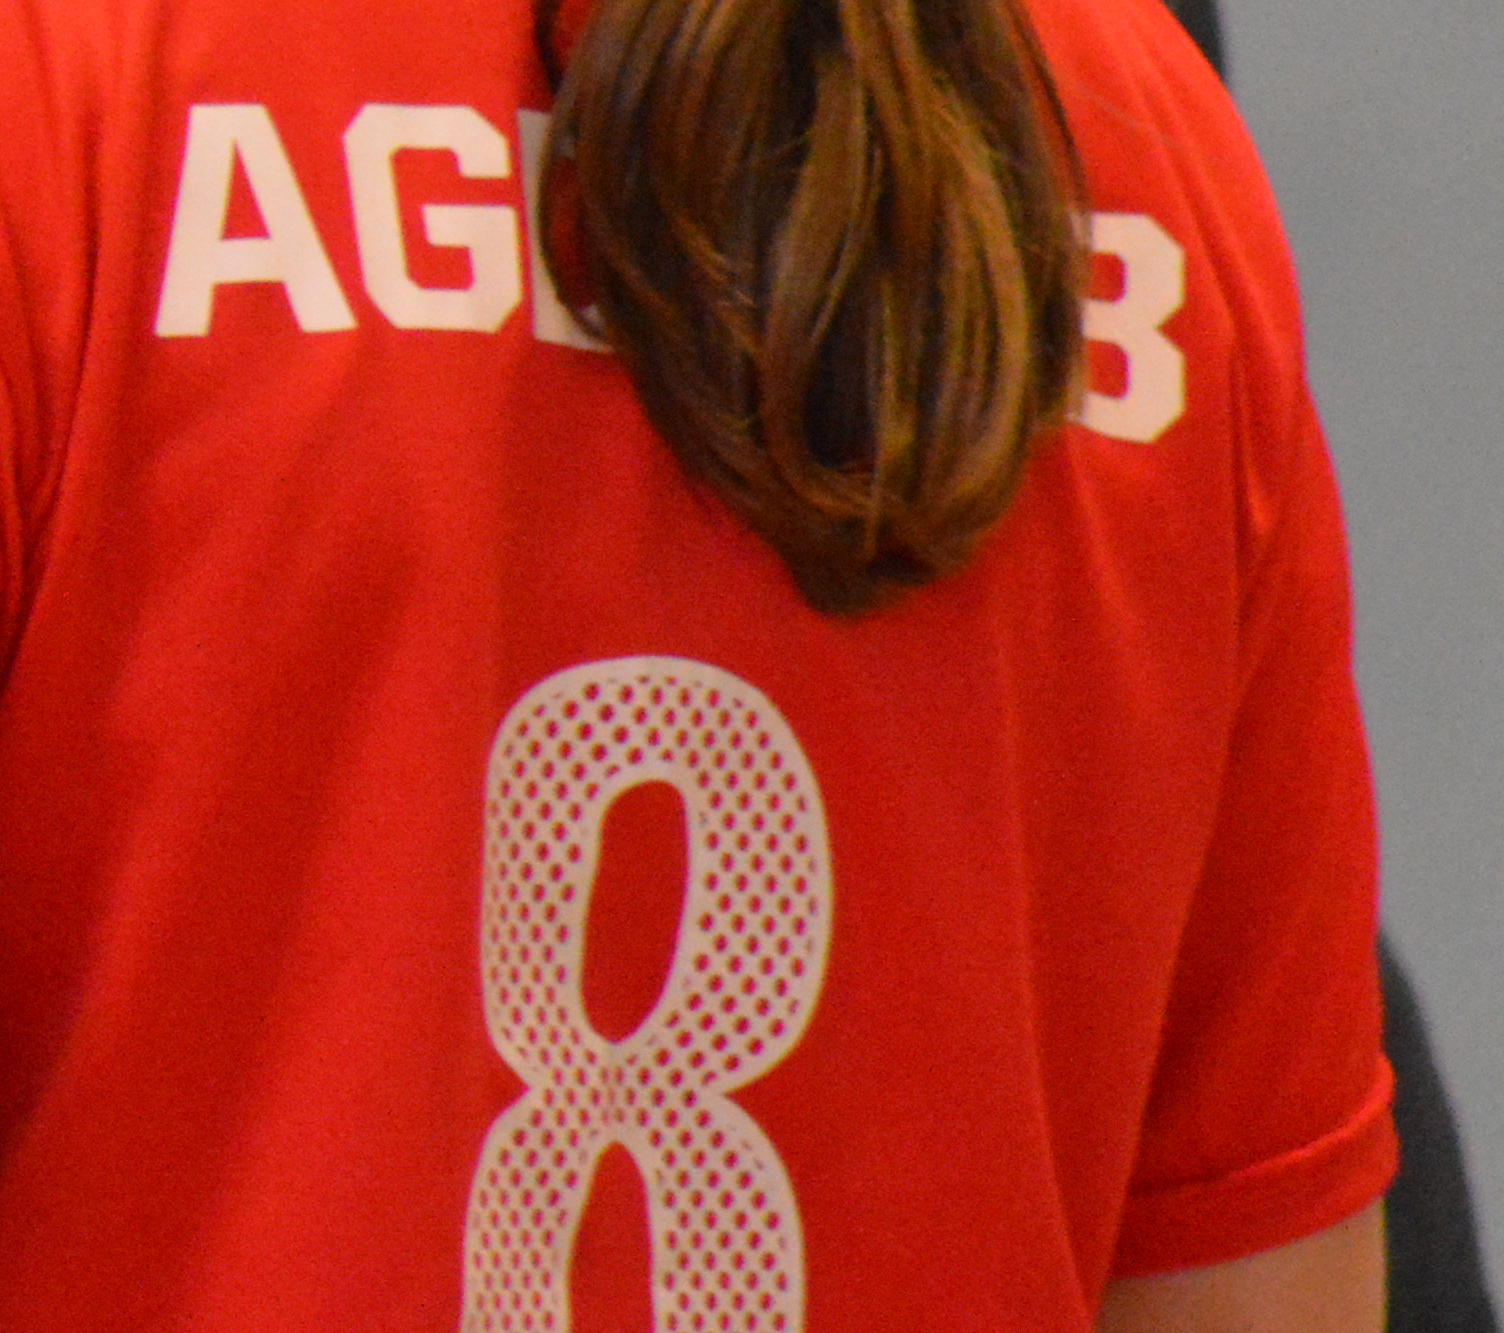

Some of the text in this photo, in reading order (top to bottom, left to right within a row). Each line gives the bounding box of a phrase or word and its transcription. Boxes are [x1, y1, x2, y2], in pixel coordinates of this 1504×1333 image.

[155, 102, 1186, 444] AG B
[462, 655, 832, 1333] 8
